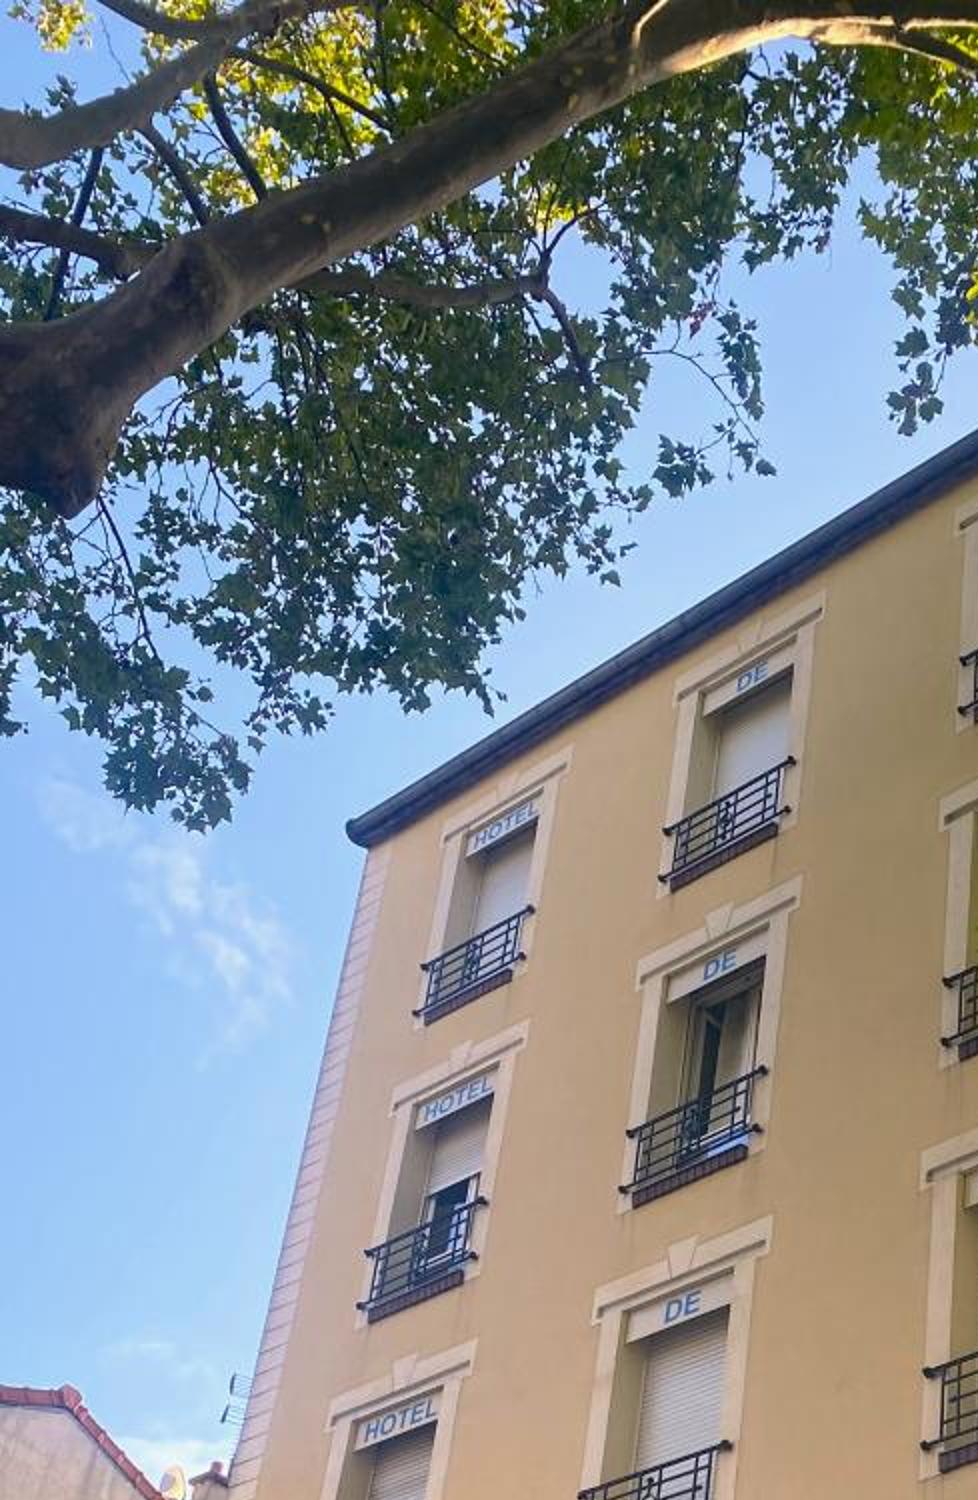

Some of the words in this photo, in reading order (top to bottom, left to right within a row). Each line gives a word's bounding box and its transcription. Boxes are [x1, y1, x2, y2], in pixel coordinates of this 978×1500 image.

[736, 662, 769, 692] DE
[474, 802, 536, 850] HOTEL
[703, 950, 737, 981] DE
[422, 1076, 491, 1122] HOTEL
[663, 1292, 700, 1324] DE
[362, 1399, 437, 1443] HOTEL
